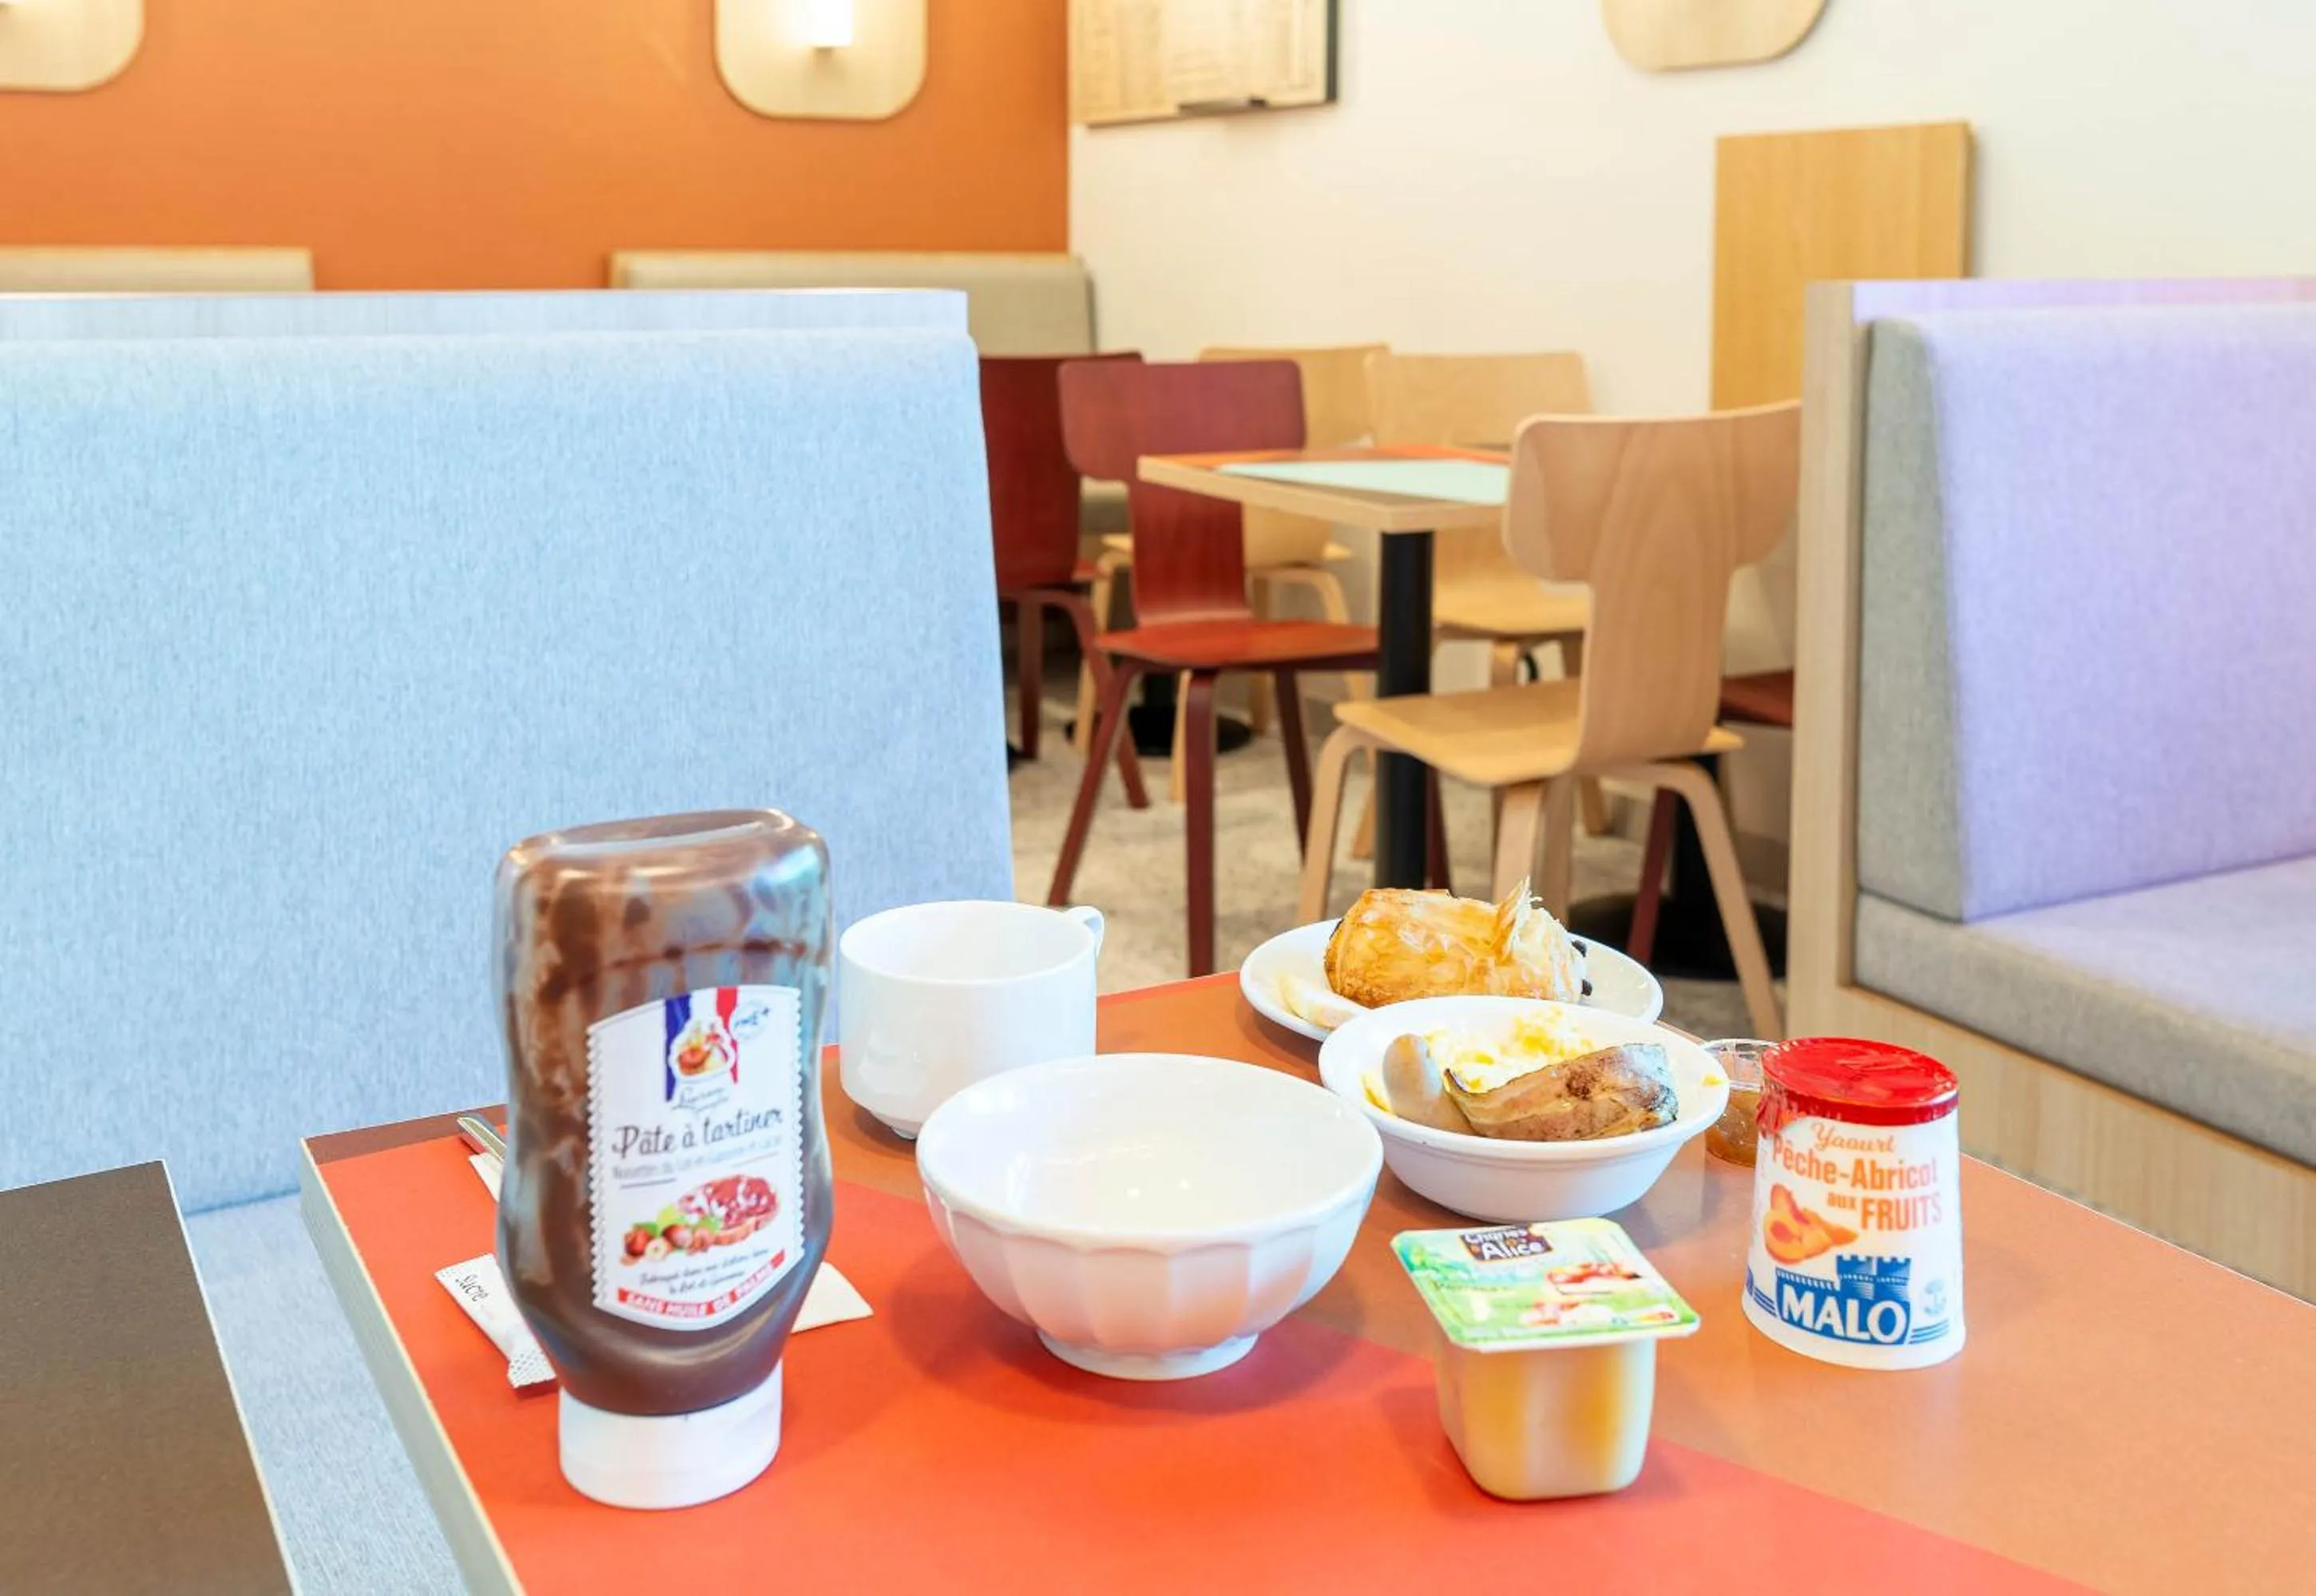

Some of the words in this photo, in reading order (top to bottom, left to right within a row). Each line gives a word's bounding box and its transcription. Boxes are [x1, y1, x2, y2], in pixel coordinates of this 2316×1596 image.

[612, 1125, 677, 1160] Pâte
[682, 1123, 697, 1148] à
[703, 1108, 783, 1144] tartiner
[1810, 1121, 1896, 1152] Yaourt
[1826, 1191, 1857, 1210] aux
[1861, 1192, 1943, 1231] FRUITS
[1481, 1241, 1544, 1260] Alice
[1782, 1283, 1907, 1343] MALO
